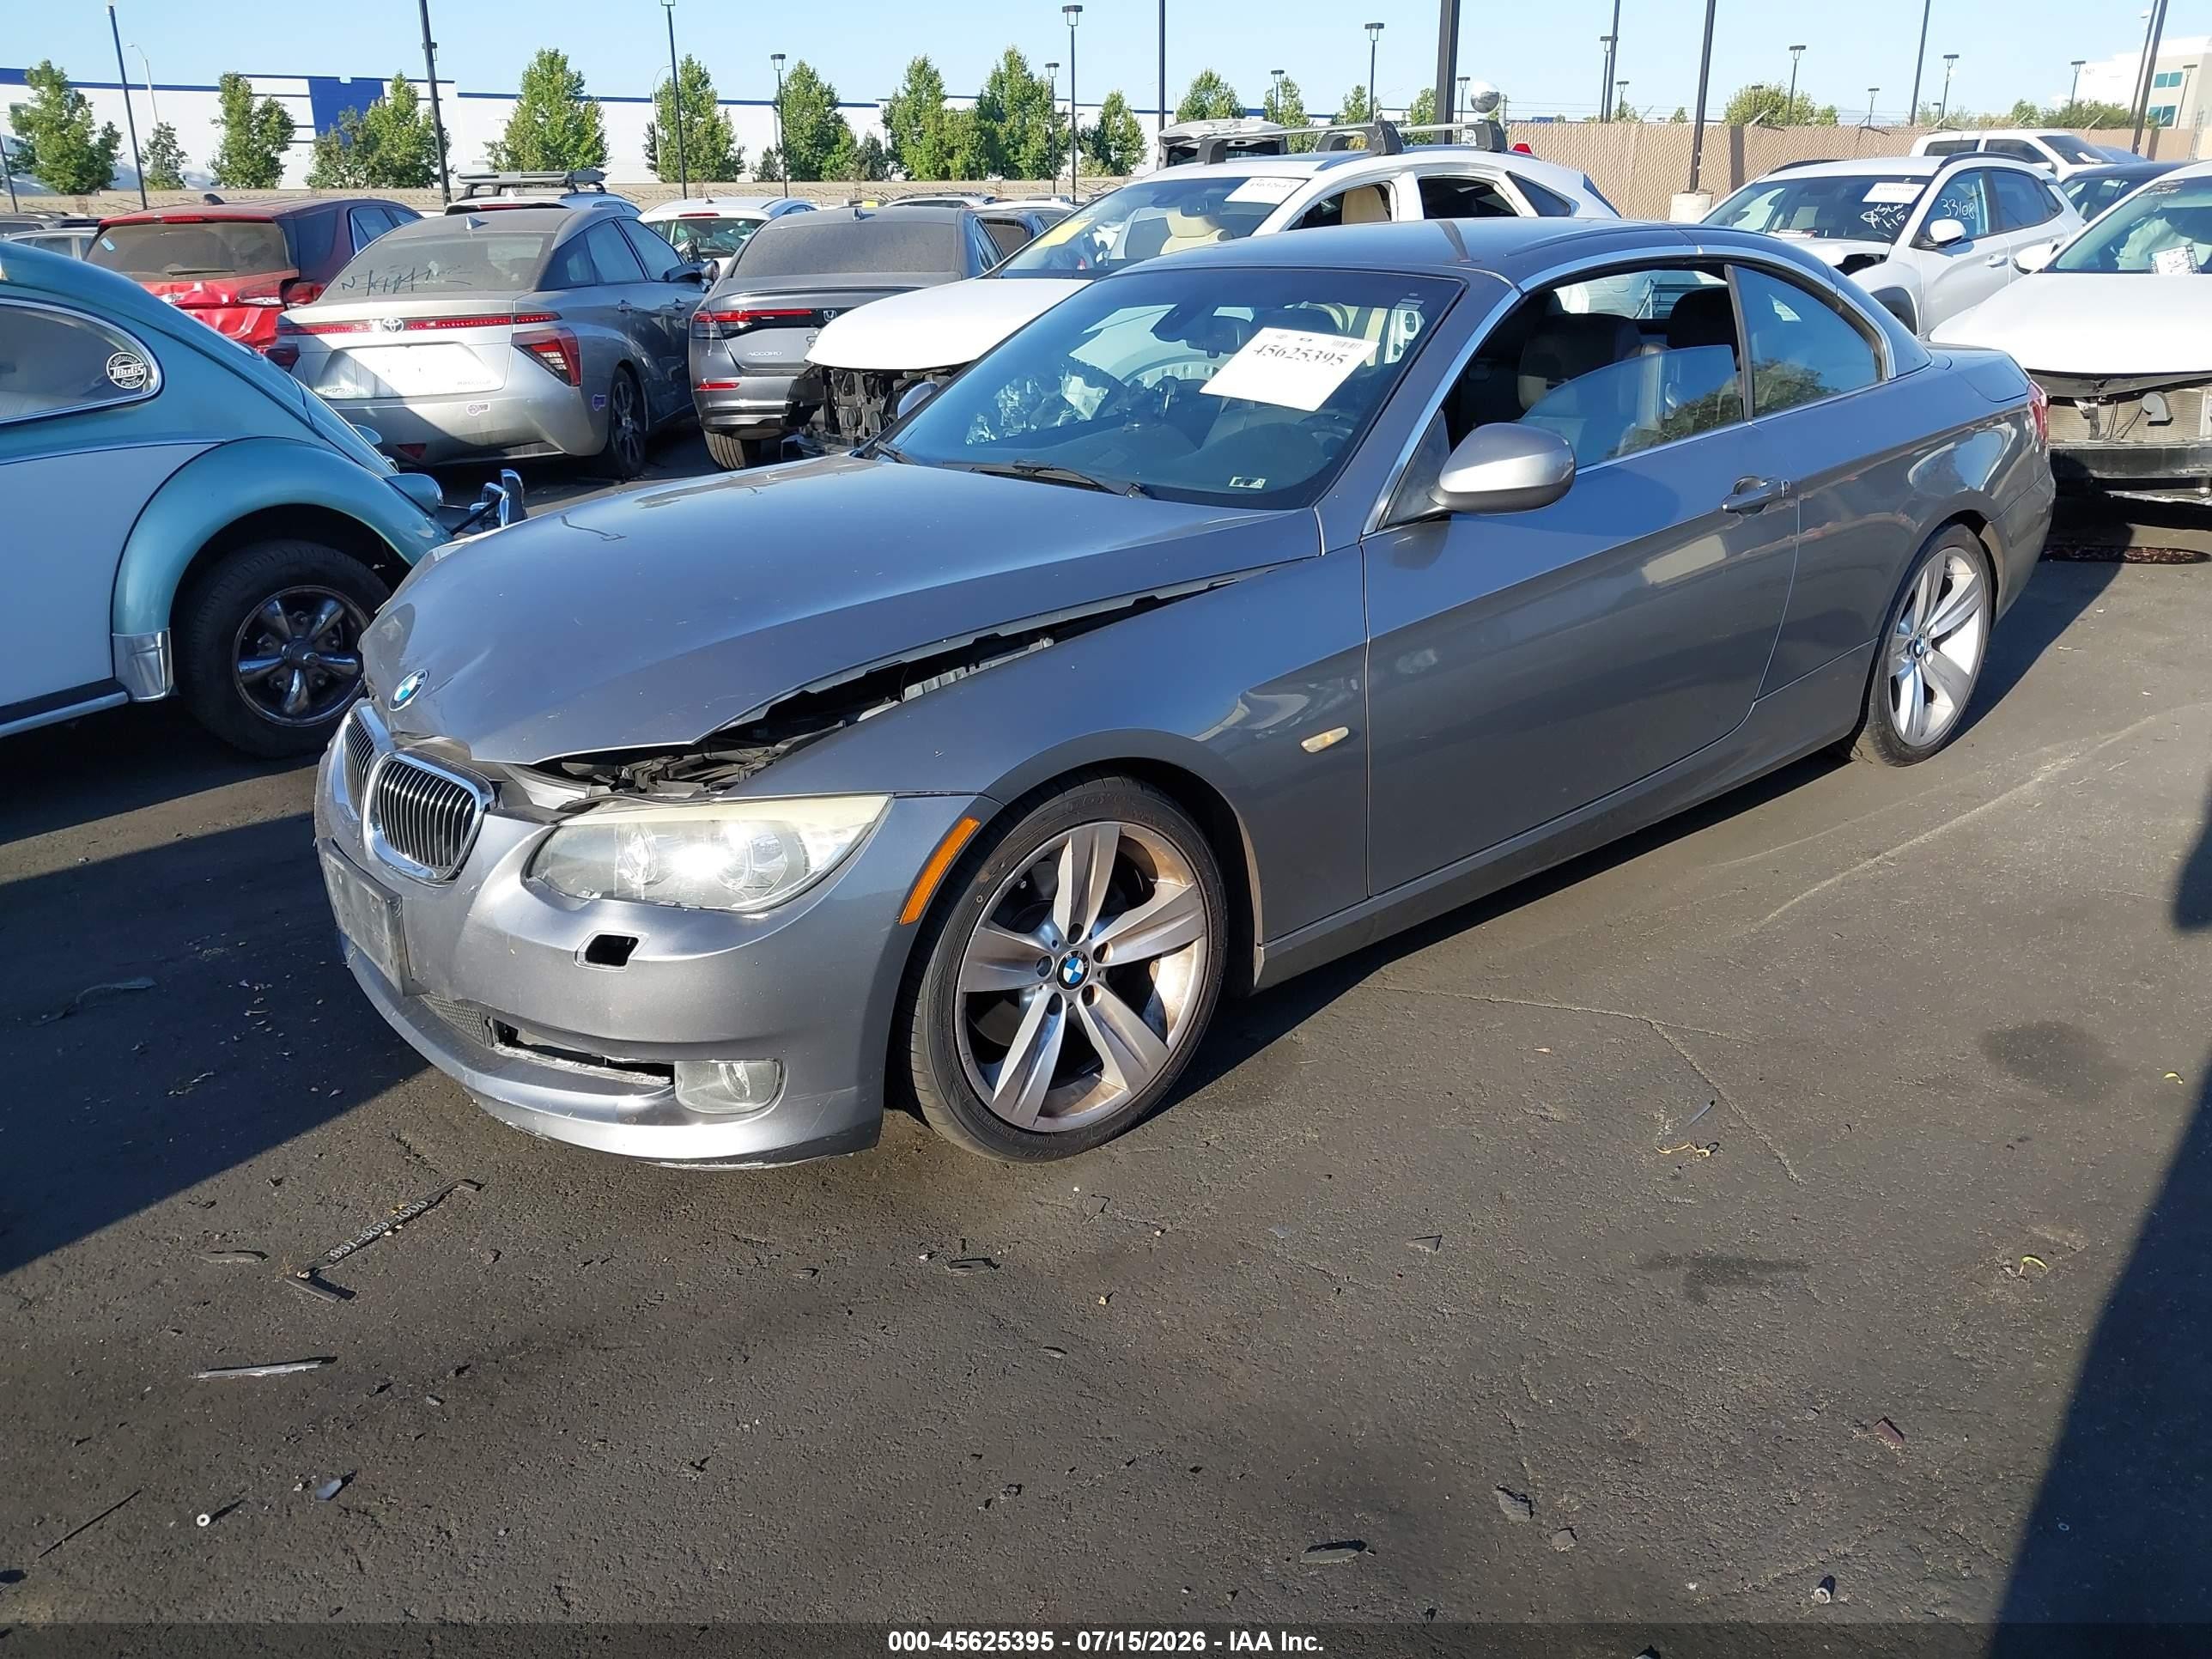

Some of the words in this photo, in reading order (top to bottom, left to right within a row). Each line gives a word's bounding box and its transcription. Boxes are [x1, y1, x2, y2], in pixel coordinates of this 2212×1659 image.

[1941, 198, 1976, 220] 33108
[110, 355, 138, 367] California
[1253, 343, 1349, 366] 45625395
[1065, 951, 1089, 969] BMW
